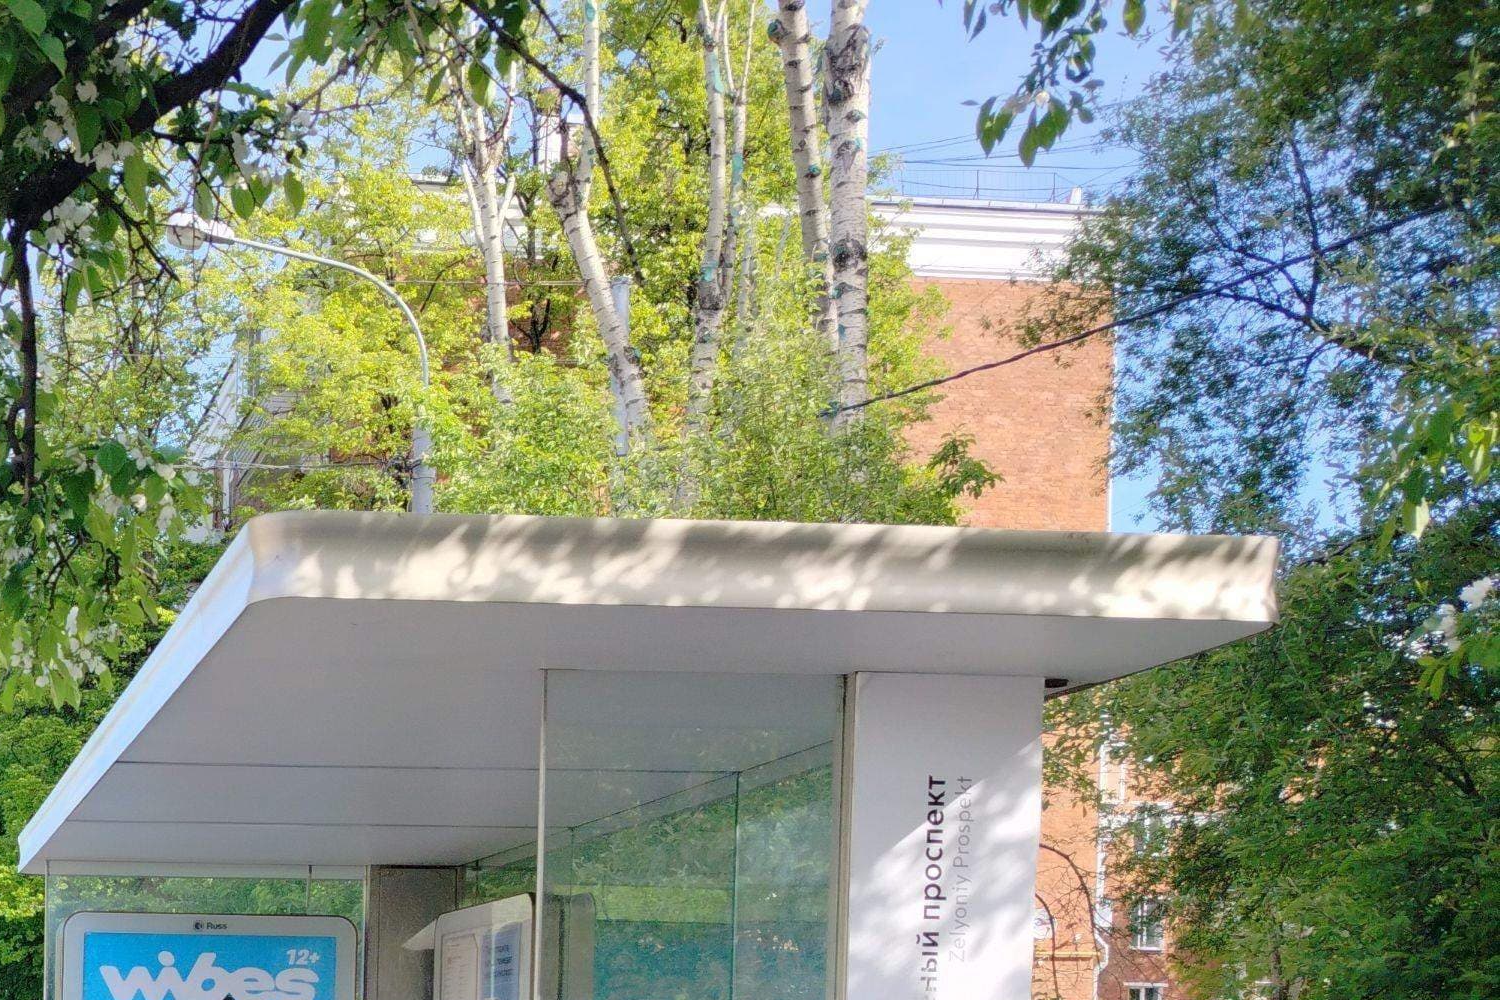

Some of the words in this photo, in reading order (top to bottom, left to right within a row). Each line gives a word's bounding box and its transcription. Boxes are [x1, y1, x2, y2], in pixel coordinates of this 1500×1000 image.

[923, 775, 947, 920] проспект
[952, 776, 974, 868] Prospekt
[206, 921, 228, 930] Russ
[287, 949, 320, 966] 12+
[949, 875, 971, 962] Zelyoniy
